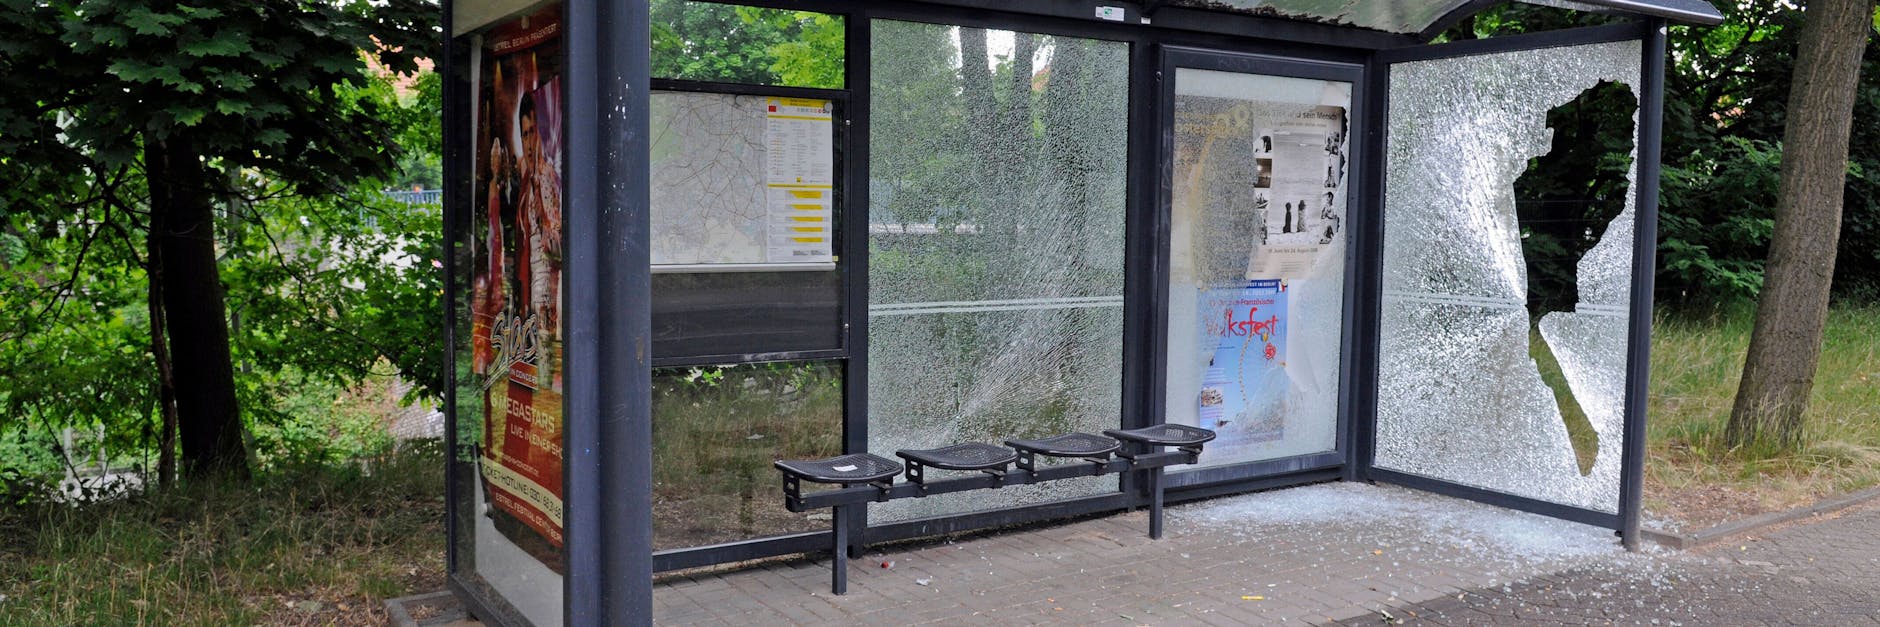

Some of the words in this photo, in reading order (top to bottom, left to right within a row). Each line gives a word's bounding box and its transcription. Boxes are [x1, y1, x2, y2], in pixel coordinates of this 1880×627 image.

[499, 394, 555, 433] MEGASTARS
[510, 423, 524, 438] LIVE
[524, 431, 532, 442] IN
[532, 433, 551, 452] EINER
